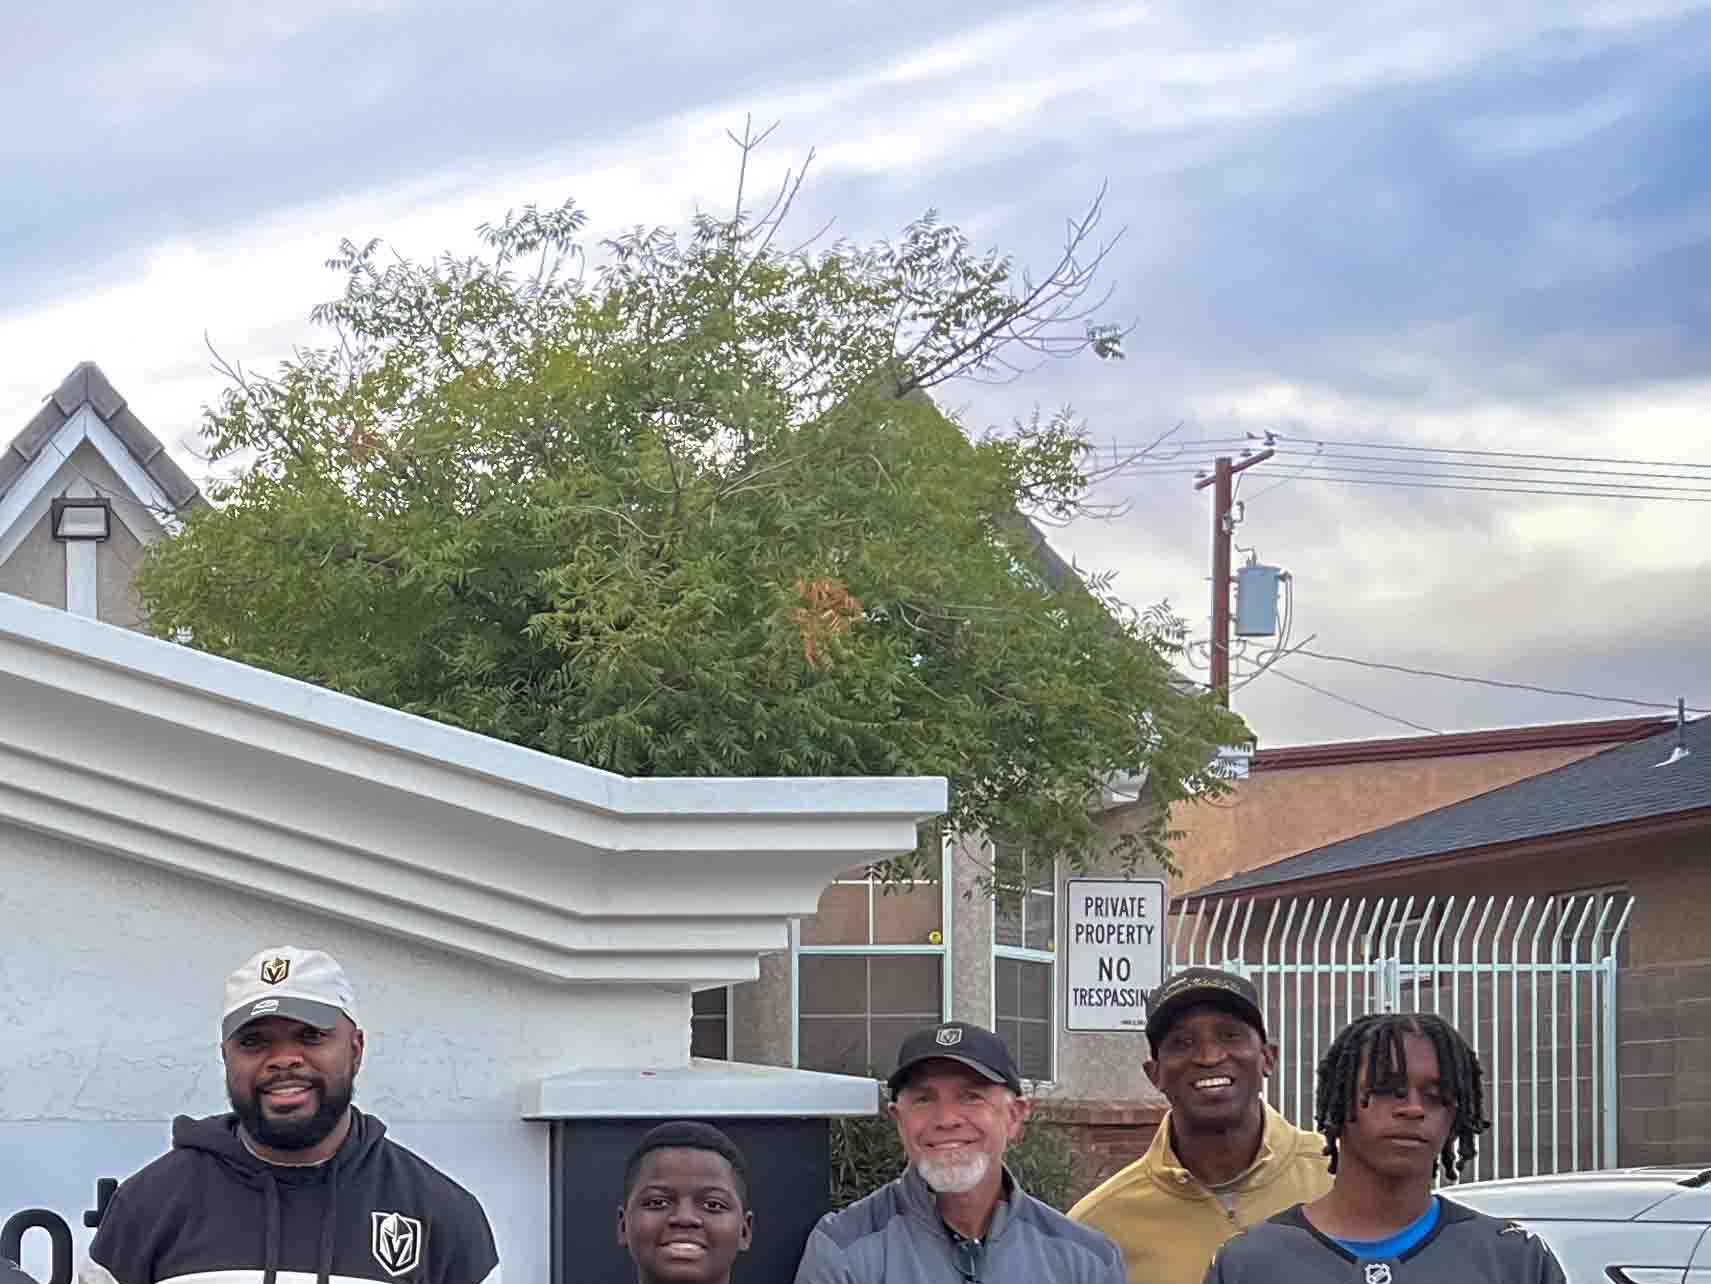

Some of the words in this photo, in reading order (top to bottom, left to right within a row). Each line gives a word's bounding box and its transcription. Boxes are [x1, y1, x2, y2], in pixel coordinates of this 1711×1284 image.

[1084, 896, 1147, 918] PRIVATE
[1075, 923, 1155, 945] PROPERTY
[1098, 956, 1132, 982] NO
[1072, 987, 1152, 1007] TRESPASSIN
